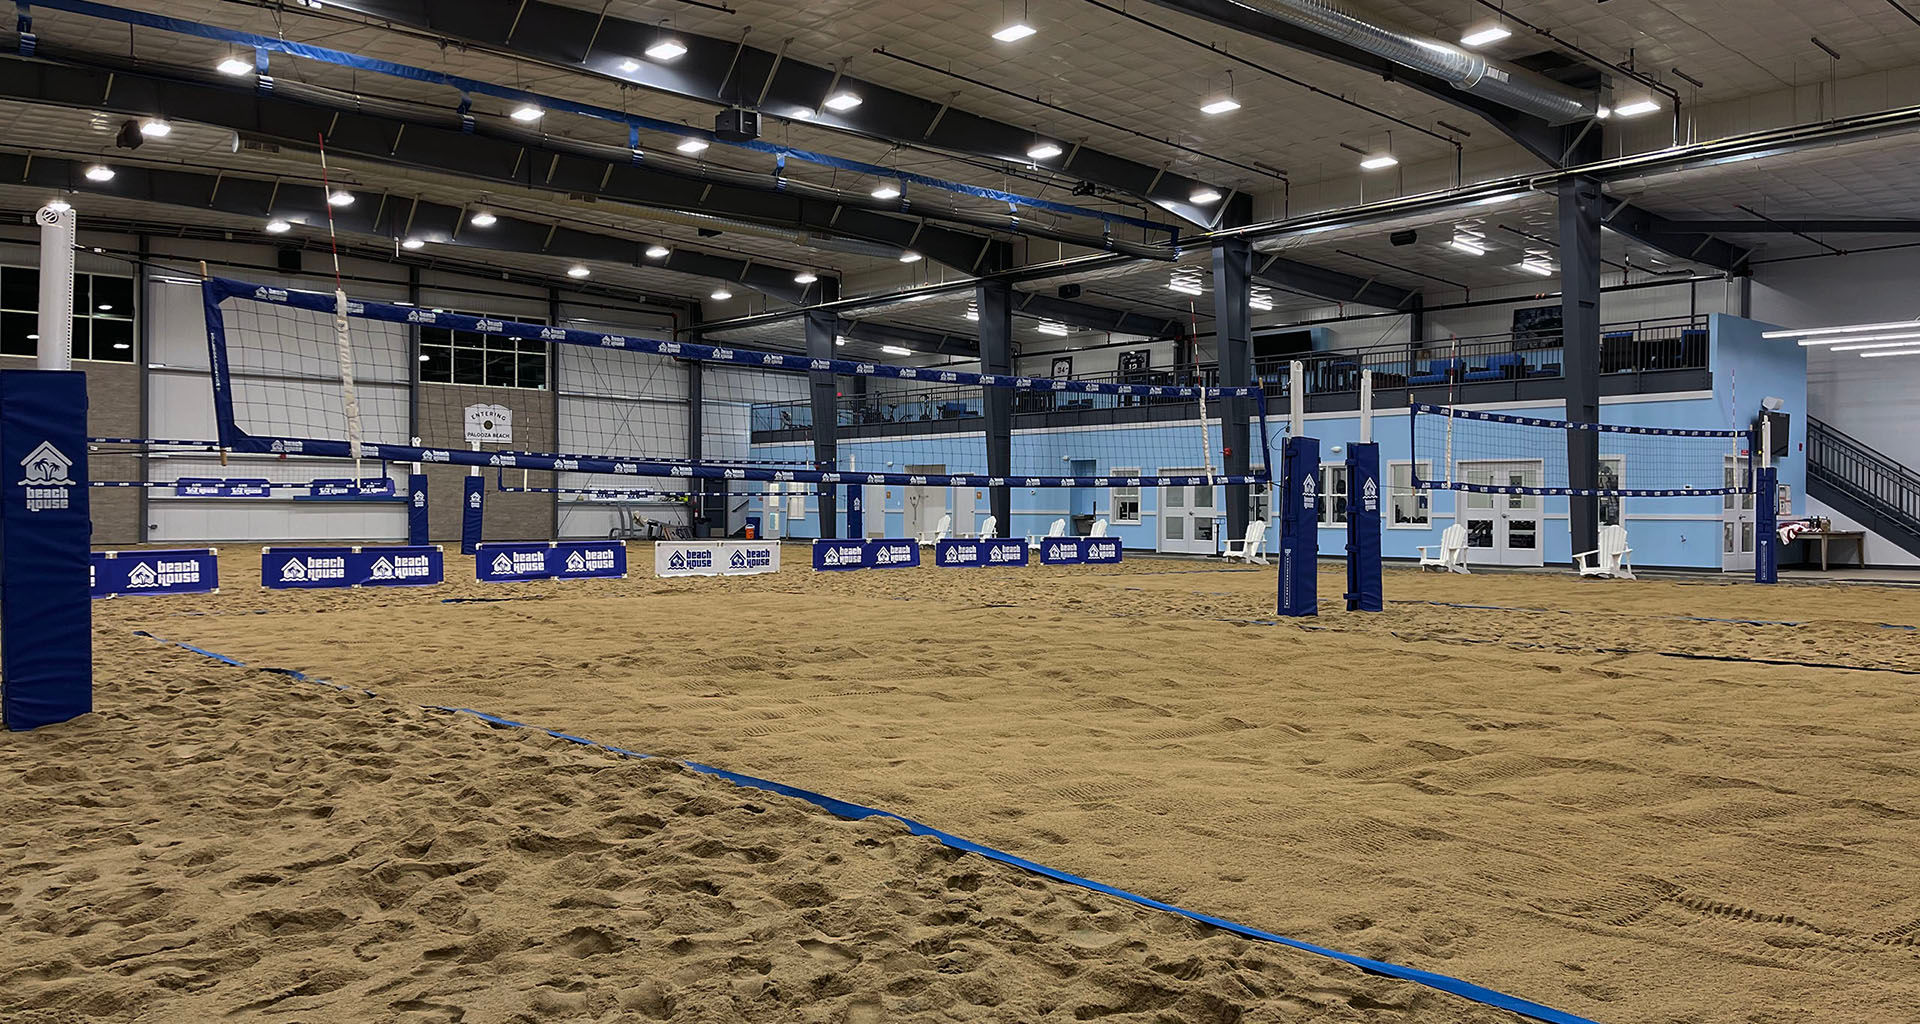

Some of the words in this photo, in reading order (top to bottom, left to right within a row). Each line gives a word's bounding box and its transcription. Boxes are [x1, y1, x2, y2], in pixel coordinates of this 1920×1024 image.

[471, 411, 507, 421] ENTERING
[26, 487, 68, 499] beach
[513, 551, 544, 562] beach
[585, 549, 614, 560] beach
[686, 549, 712, 559] beach
[746, 548, 770, 558] beach
[157, 560, 199, 573] beach
[307, 556, 345, 568] beach
[395, 555, 428, 567] beach
